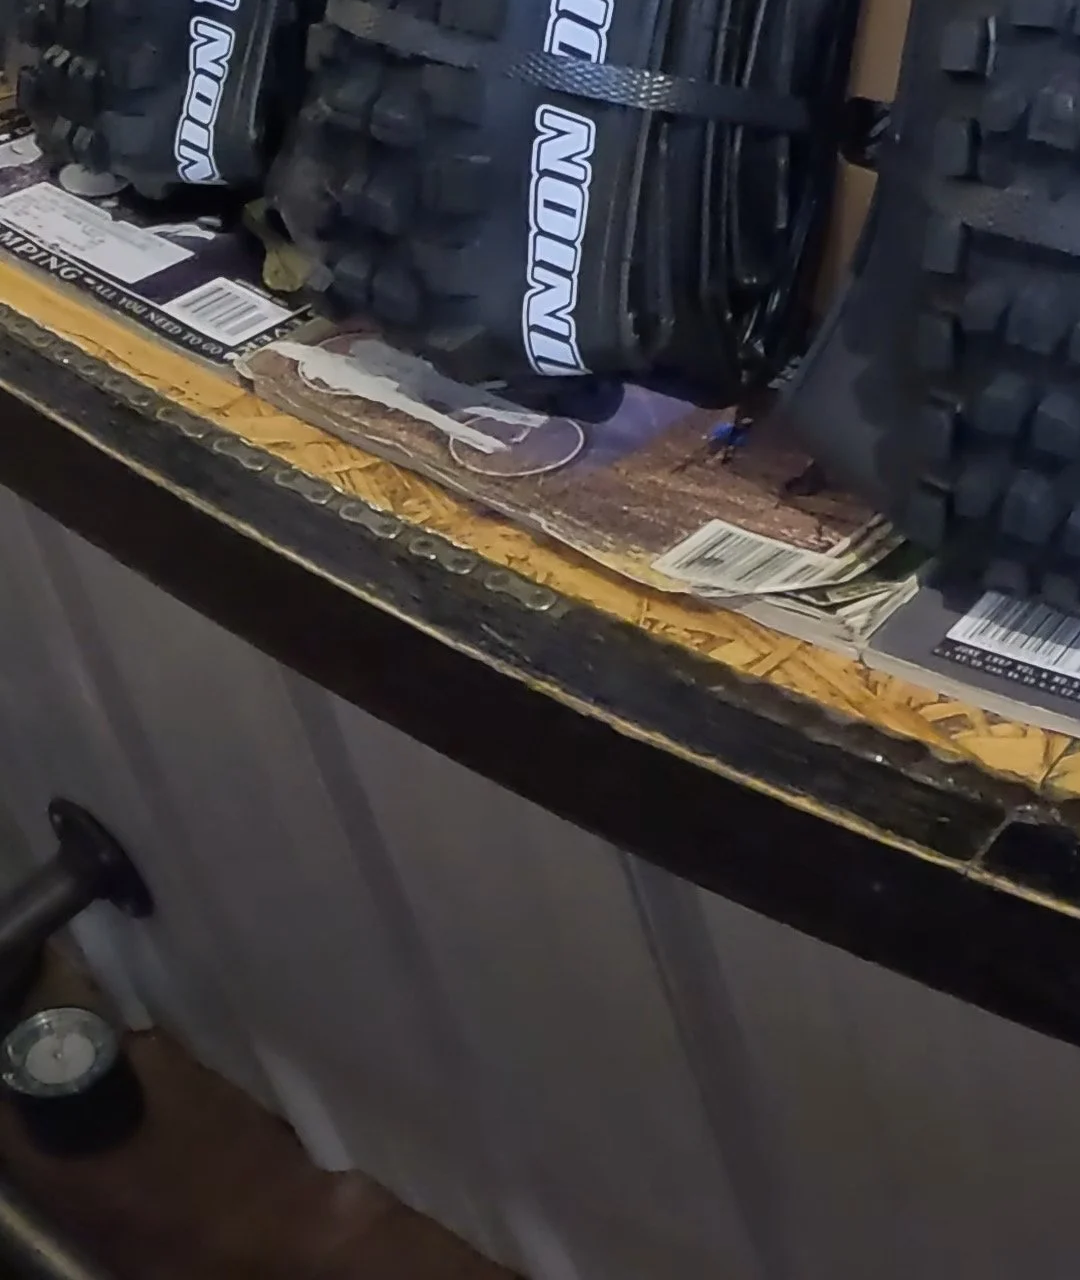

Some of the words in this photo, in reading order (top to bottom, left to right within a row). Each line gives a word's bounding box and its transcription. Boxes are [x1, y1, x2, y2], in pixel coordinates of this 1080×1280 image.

[0, 230, 84, 280] MPING
[150, 310, 182, 335] NEED
[522, 103, 595, 376] INION
